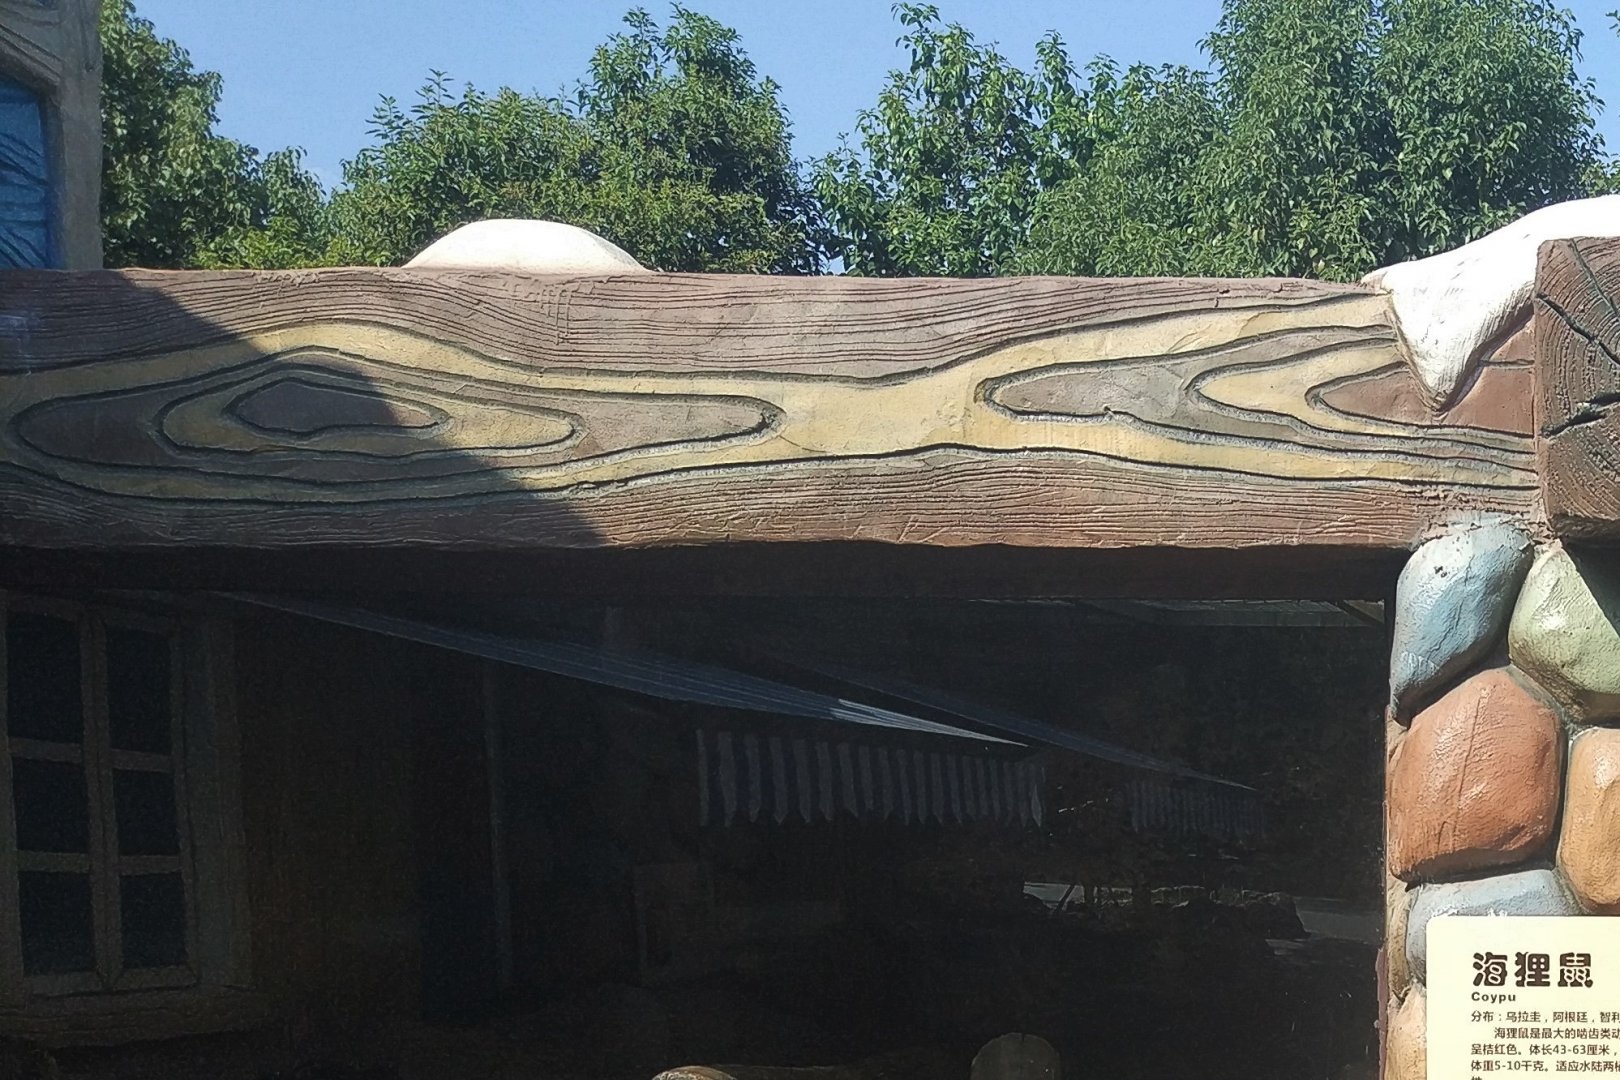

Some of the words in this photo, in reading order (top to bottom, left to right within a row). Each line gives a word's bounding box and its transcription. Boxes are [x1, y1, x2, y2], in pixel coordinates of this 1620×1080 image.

[1473, 952, 1593, 988] 海狸鼠
[1471, 992, 1515, 1004] Coypu
